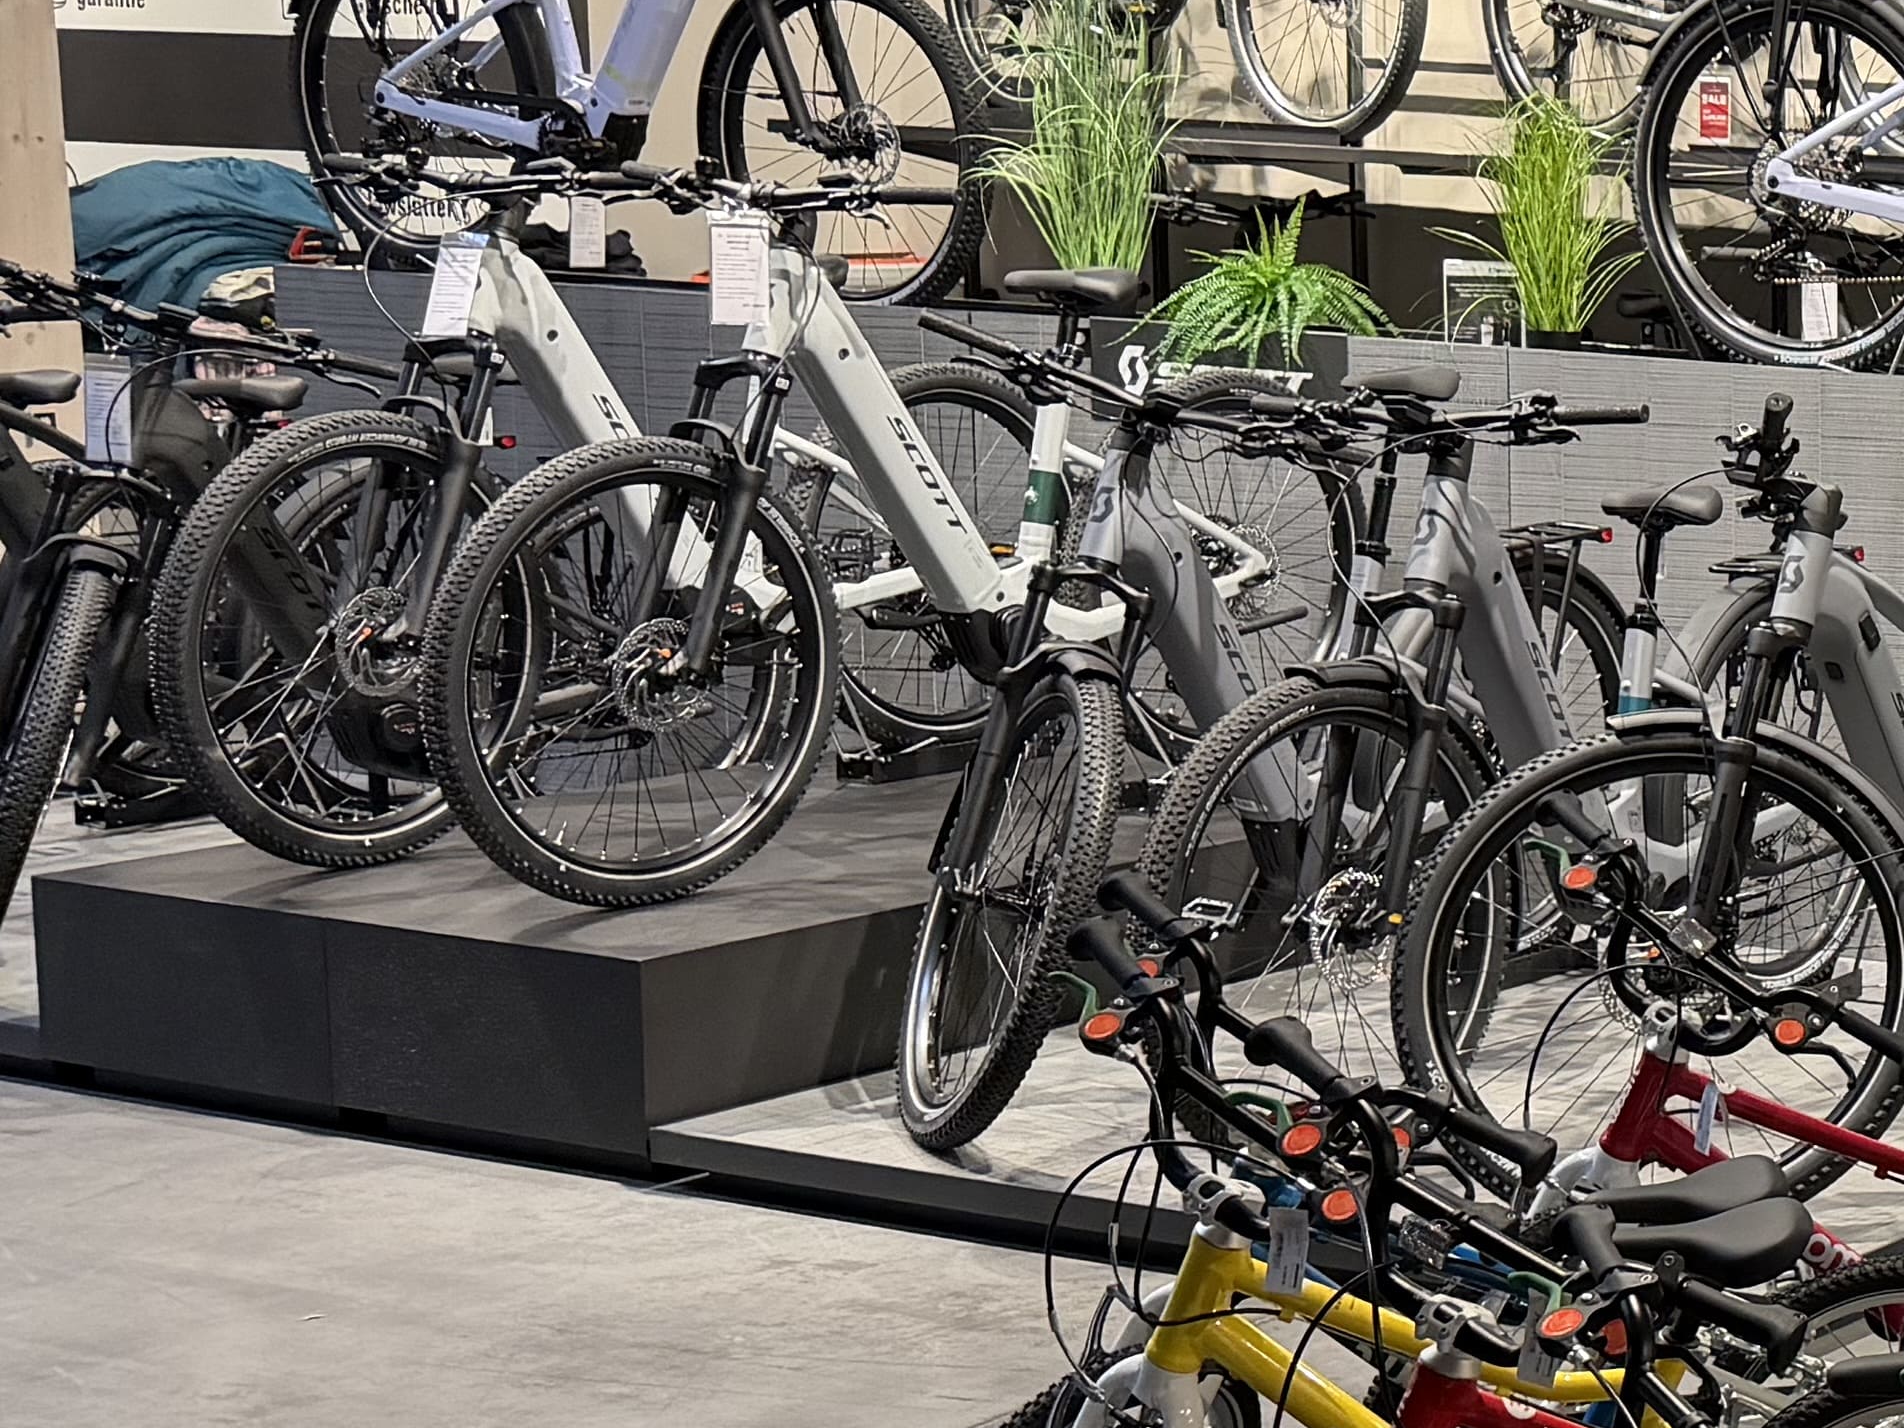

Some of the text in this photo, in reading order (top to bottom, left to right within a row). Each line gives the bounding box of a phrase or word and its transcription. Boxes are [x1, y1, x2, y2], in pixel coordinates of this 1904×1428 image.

[886, 414, 968, 535] SCOTT
[1214, 623, 1258, 697] SCO
[1526, 640, 1575, 740] SCOT
